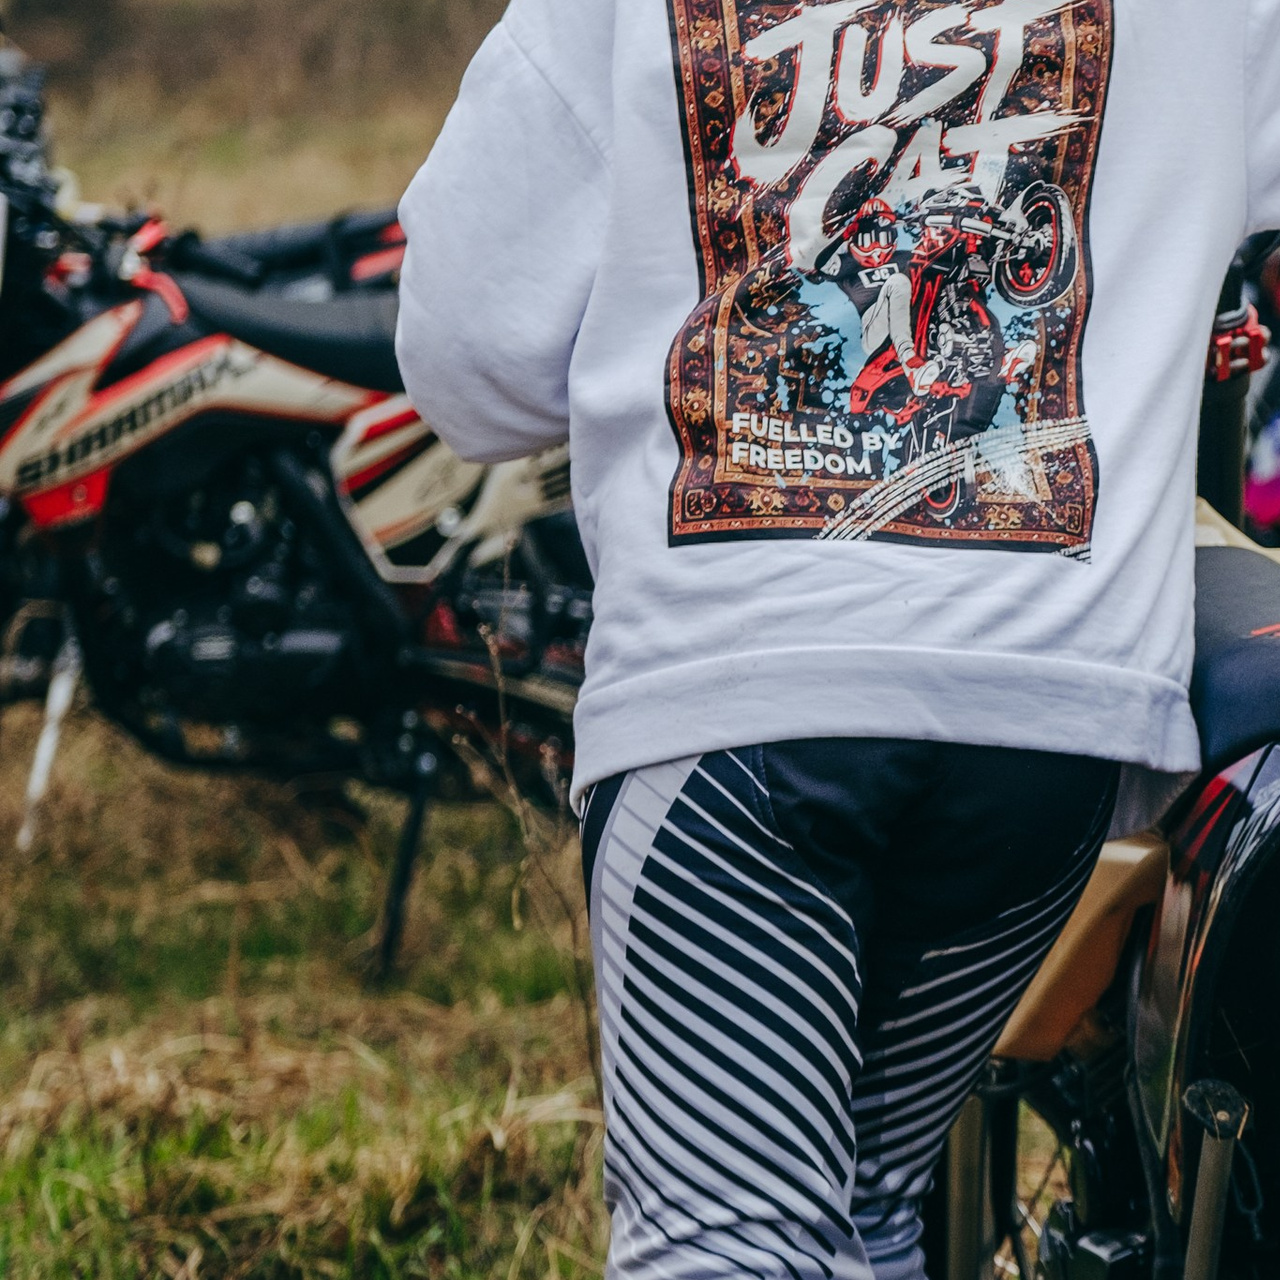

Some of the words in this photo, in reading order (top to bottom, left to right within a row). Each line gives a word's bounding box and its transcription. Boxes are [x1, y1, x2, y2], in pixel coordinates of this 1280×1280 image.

[731, 412, 854, 450] FUELLED
[861, 431, 900, 451] BY
[731, 441, 872, 476] FREEDOM
